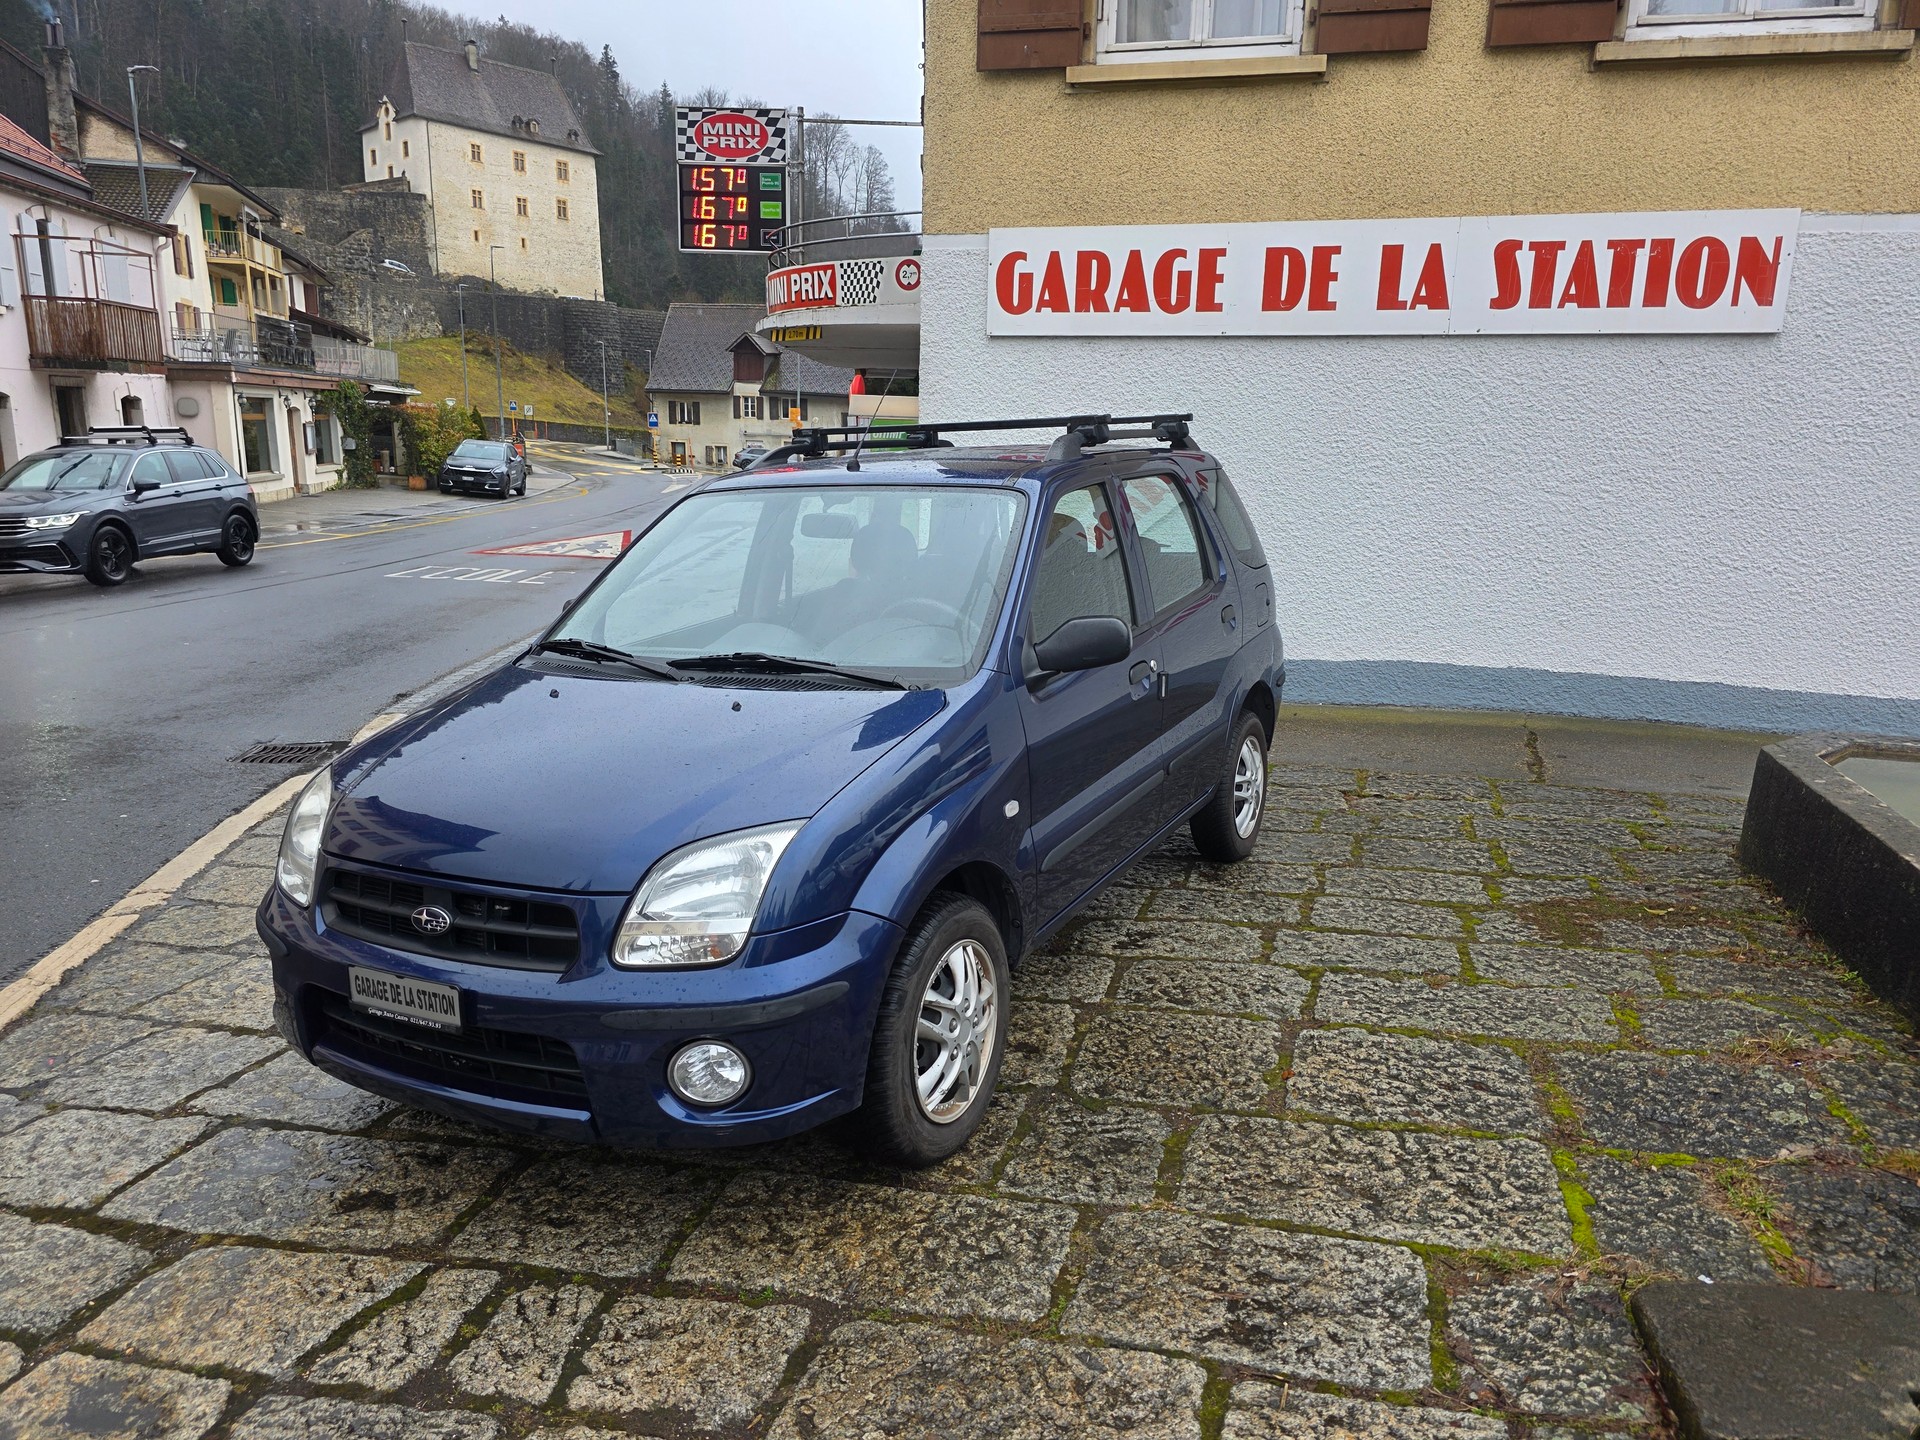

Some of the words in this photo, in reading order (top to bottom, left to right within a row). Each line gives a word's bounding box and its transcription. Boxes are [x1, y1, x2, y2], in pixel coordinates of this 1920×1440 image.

[702, 122, 760, 136] MINI
[703, 136, 761, 149] PRIX
[768, 274, 788, 306] MINI
[790, 269, 833, 302] PRIX
[995, 247, 1227, 316] GARAGE
[1261, 245, 1342, 312] DE
[1376, 242, 1450, 311] LA
[1488, 235, 1783, 310] STATION
[354, 974, 389, 1003] GARAGE
[389, 982, 403, 1005] DE
[403, 985, 416, 1009] LA
[416, 988, 456, 1016] STATION
